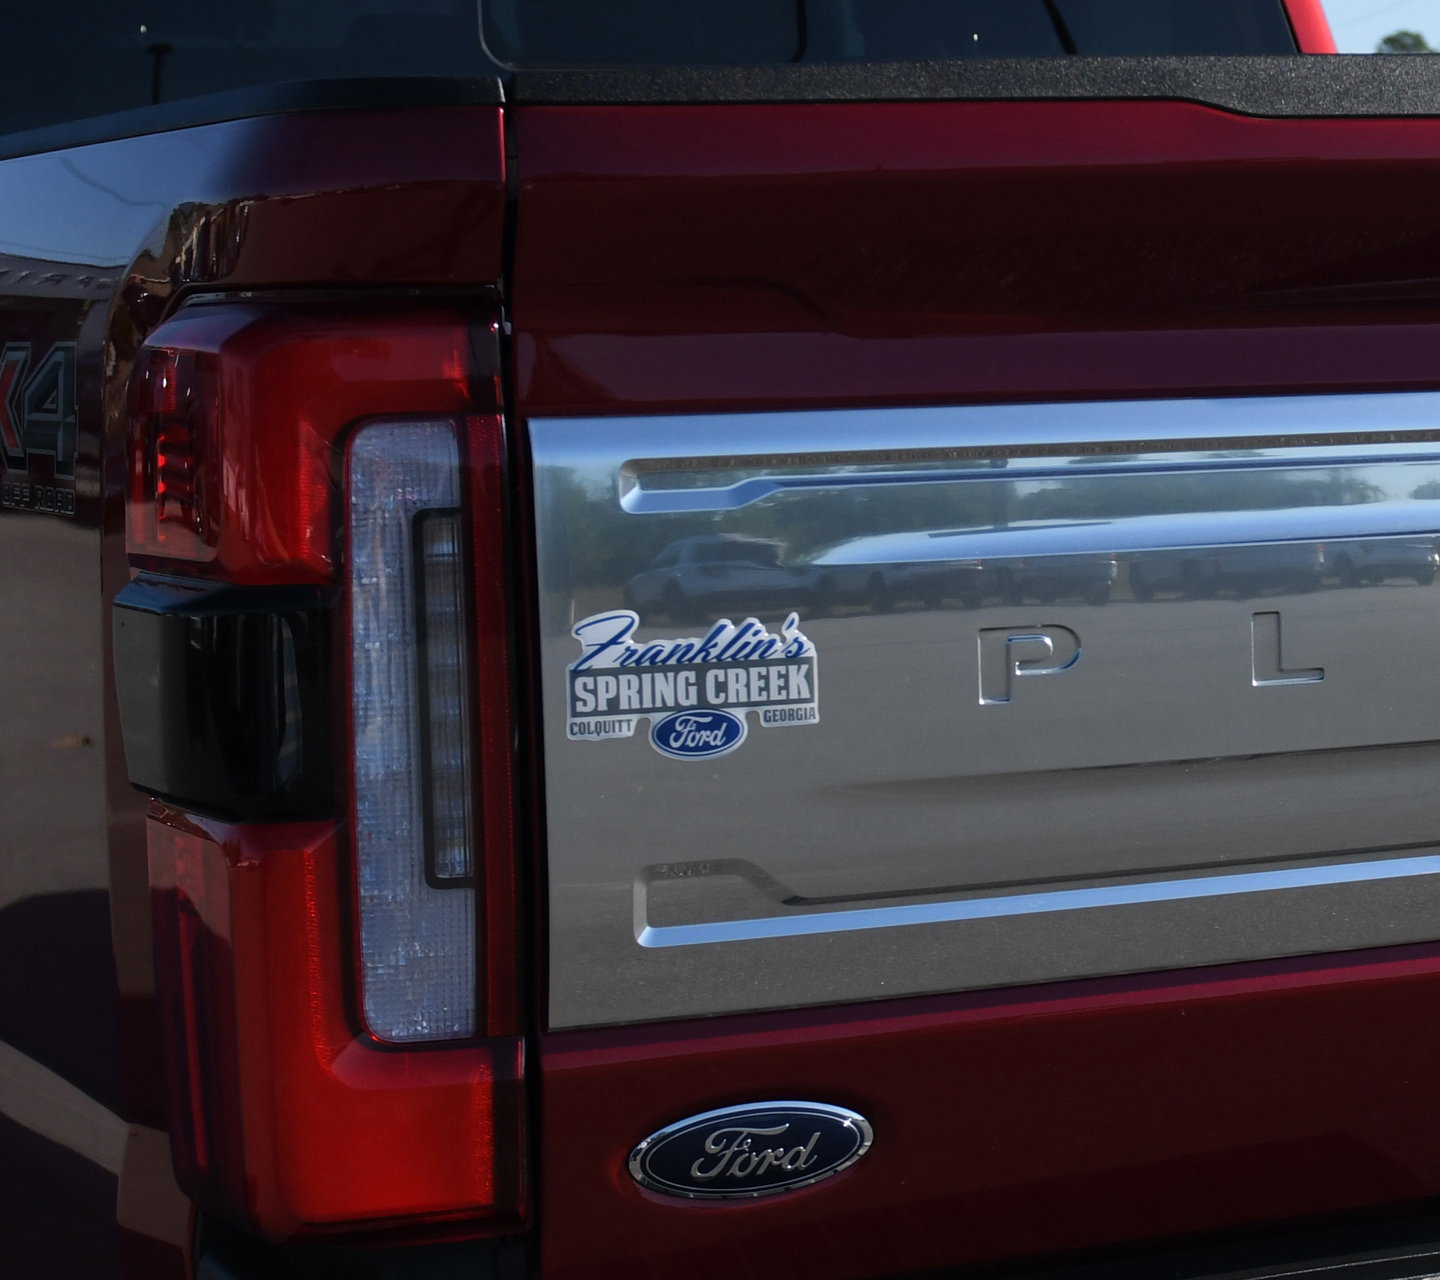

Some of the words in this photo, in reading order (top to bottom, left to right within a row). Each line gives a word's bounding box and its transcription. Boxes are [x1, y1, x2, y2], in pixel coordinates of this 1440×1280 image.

[1, 481, 31, 510] OFF
[33, 484, 76, 518] ROAD
[574, 615, 811, 670] Franklin's
[575, 671, 697, 713] SPRING
[705, 663, 812, 705] CREEK
[569, 718, 633, 737] COLQUITT
[669, 715, 727, 749] Ford
[763, 706, 817, 723] GEORGIA
[691, 1122, 820, 1179] Ford
